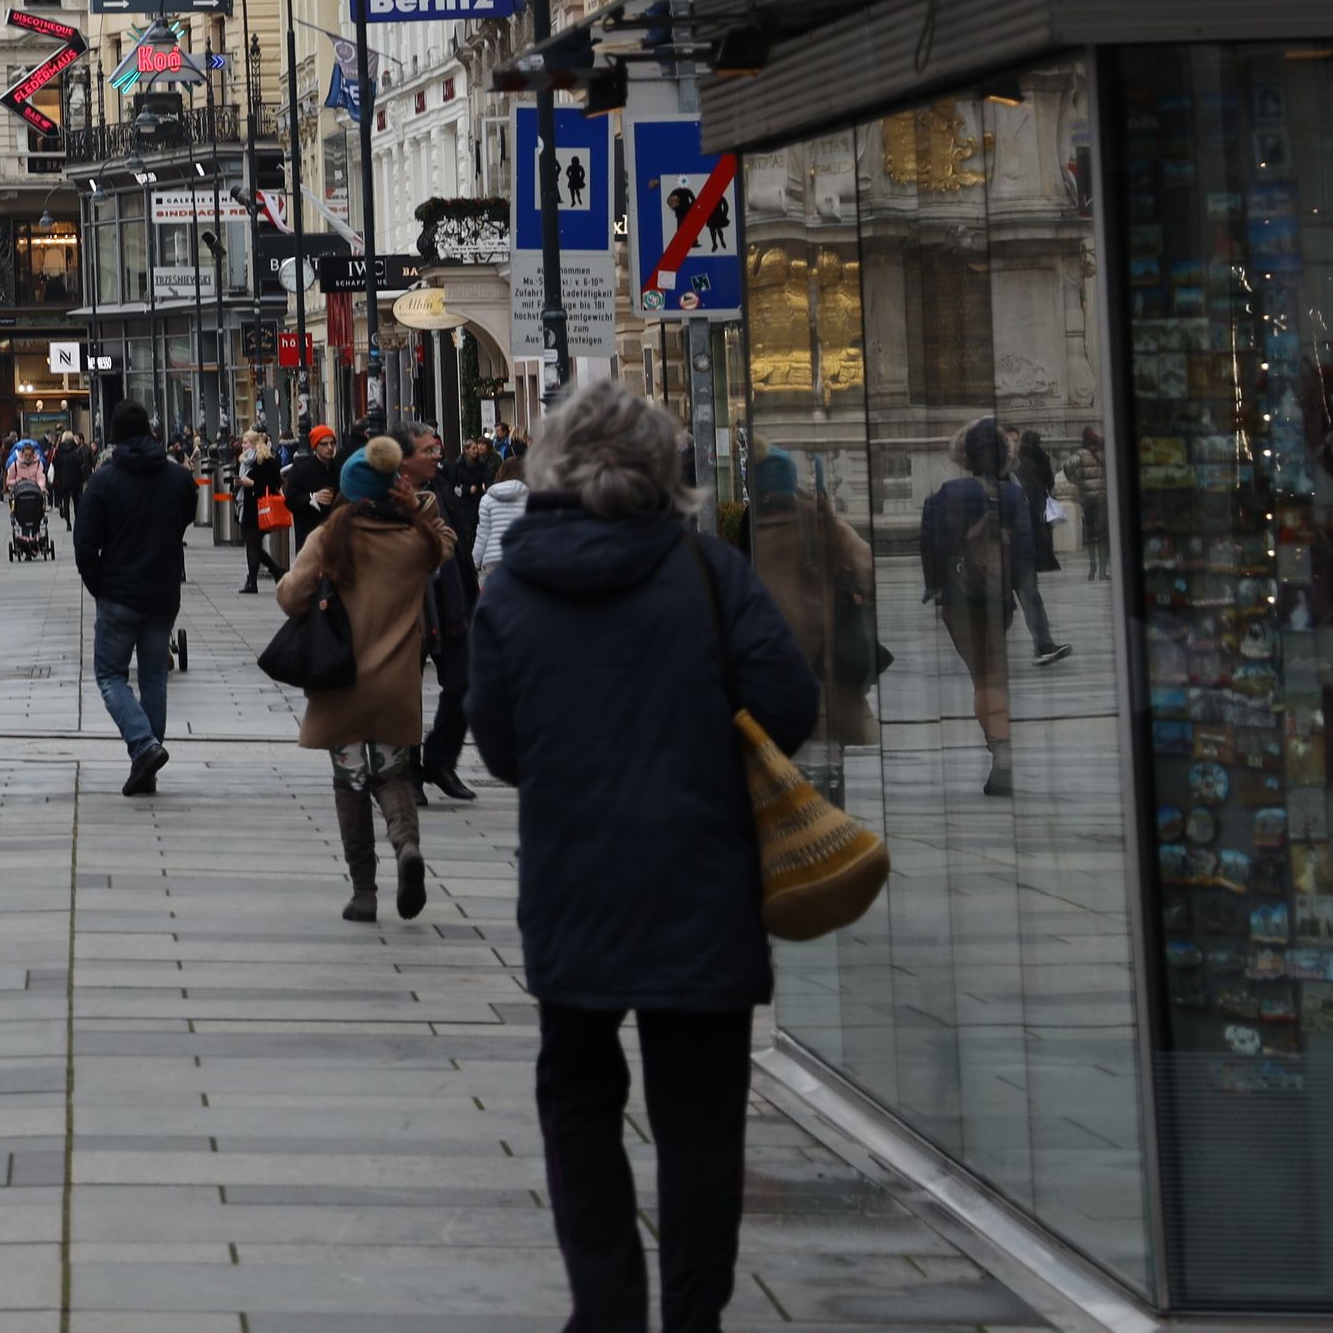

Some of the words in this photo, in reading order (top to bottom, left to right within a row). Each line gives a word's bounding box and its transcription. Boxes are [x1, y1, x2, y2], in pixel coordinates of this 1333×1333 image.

[13, 12, 75, 36] DISCOTHEQUE
[13, 49, 78, 104] FLEDERMAUS
[24, 106, 41, 122] BAR
[523, 277, 543, 286] Mo.-S
[522, 301, 534, 309] mit
[579, 301, 591, 310] bis
[566, 312, 613, 322] amtgewicht
[282, 337, 309, 348] höl
[566, 335, 603, 345] insteigen
